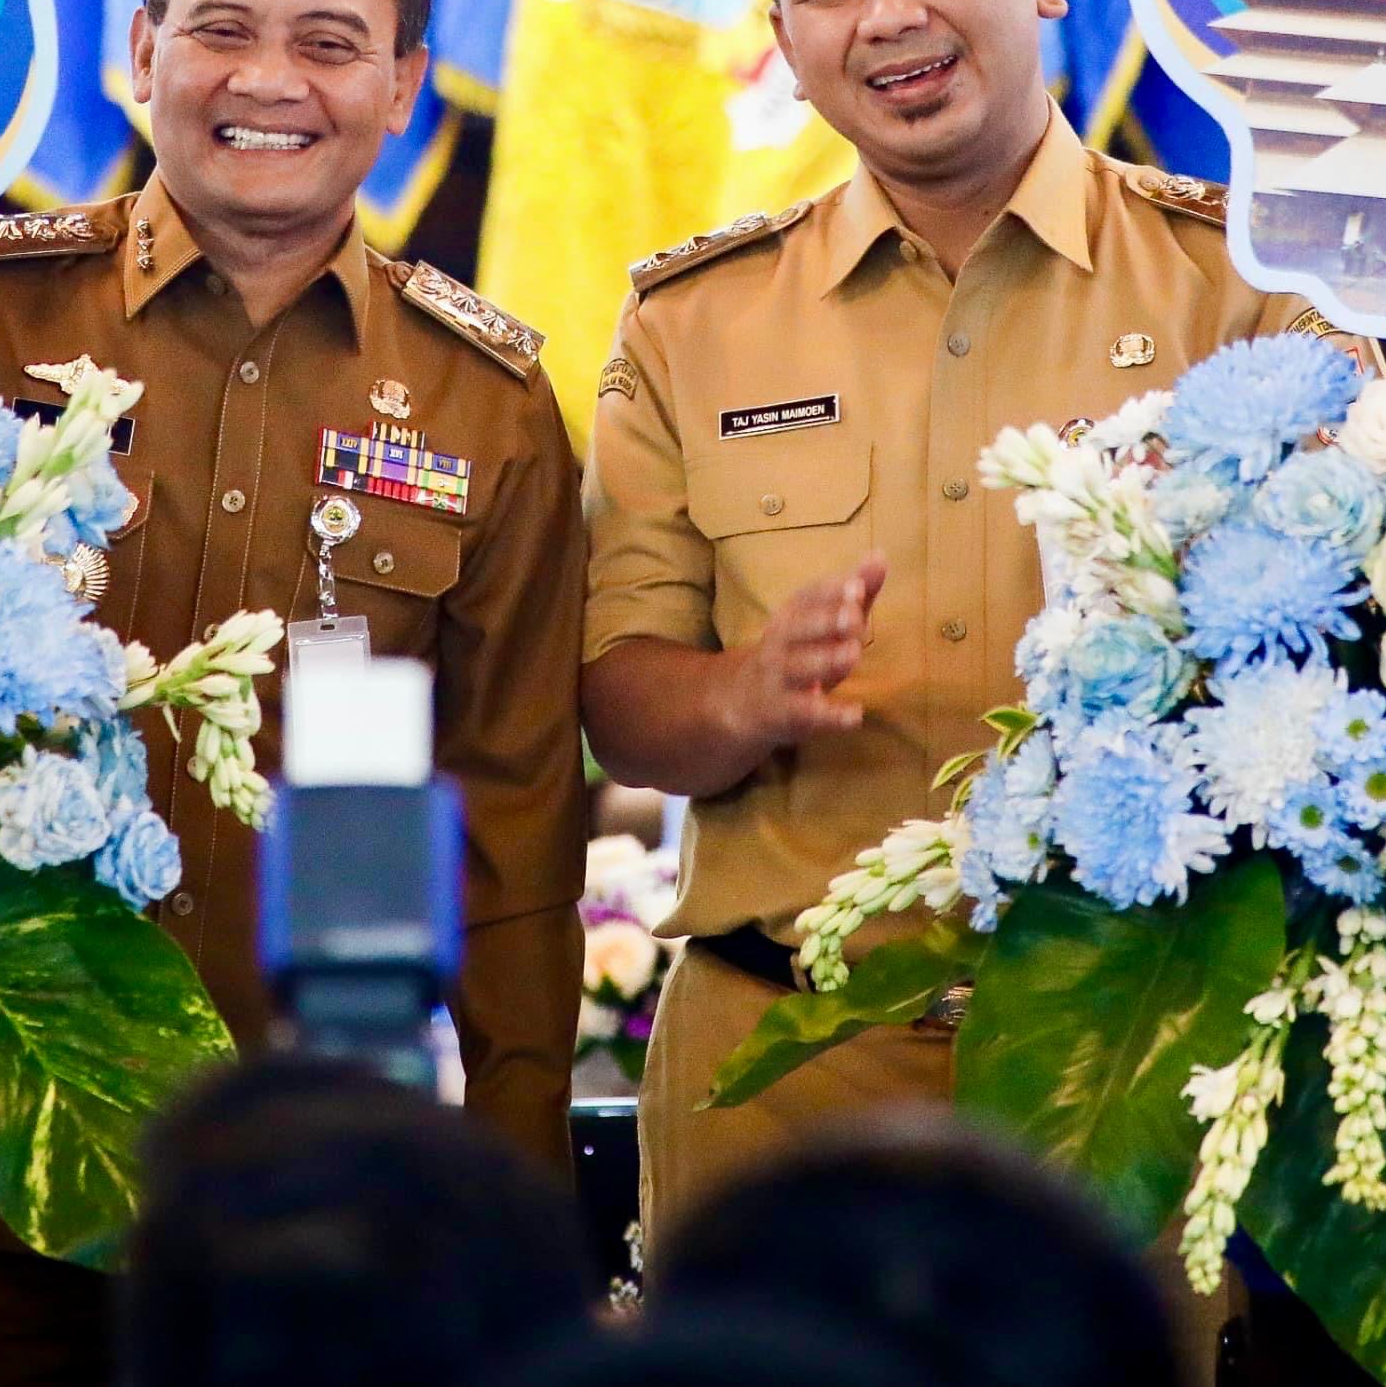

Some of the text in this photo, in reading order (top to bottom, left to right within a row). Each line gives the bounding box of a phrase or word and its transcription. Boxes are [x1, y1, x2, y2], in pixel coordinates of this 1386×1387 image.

[731, 404, 826, 428] TAJ YASIN MAIMOEN
